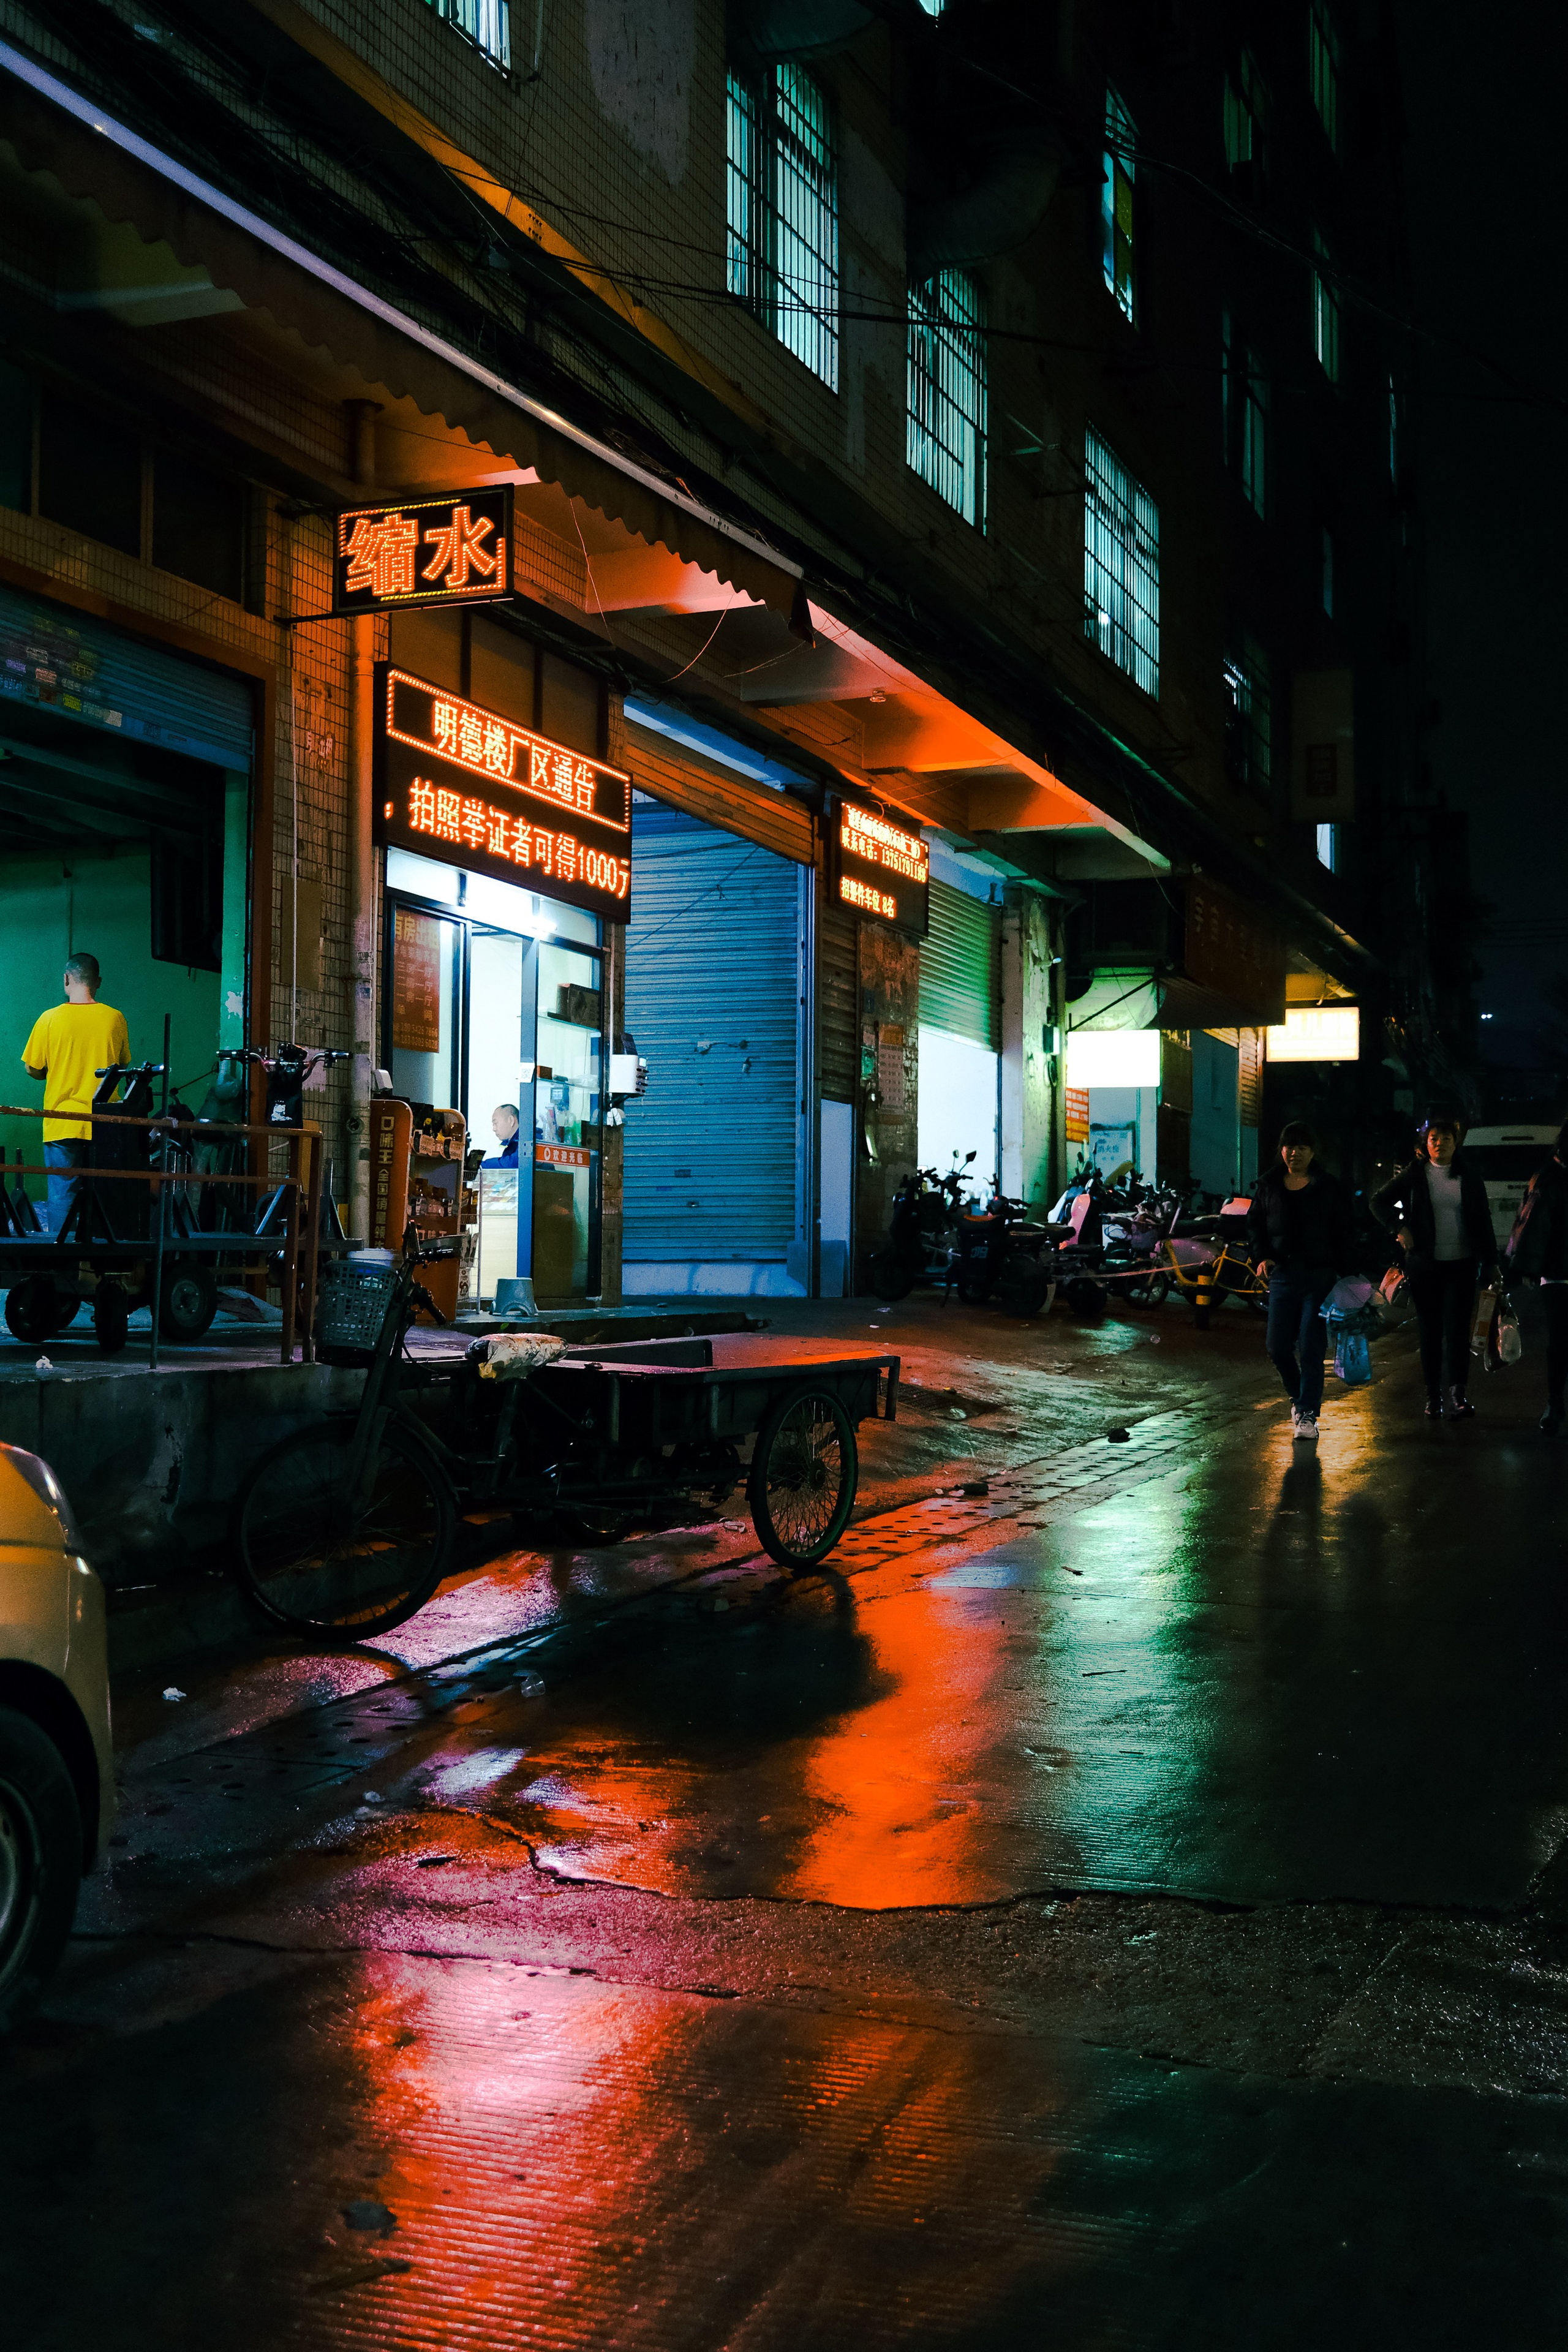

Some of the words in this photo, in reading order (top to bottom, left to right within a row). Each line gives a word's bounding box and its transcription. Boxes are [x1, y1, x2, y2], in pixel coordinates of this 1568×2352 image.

[345, 506, 495, 596] 缩水
[435, 700, 595, 811] 明德楼厂区通告
[881, 848, 927, 883] 13751791188
[378, 1116, 395, 1164] 口味王
[552, 1149, 583, 1164] 欢迎光临
